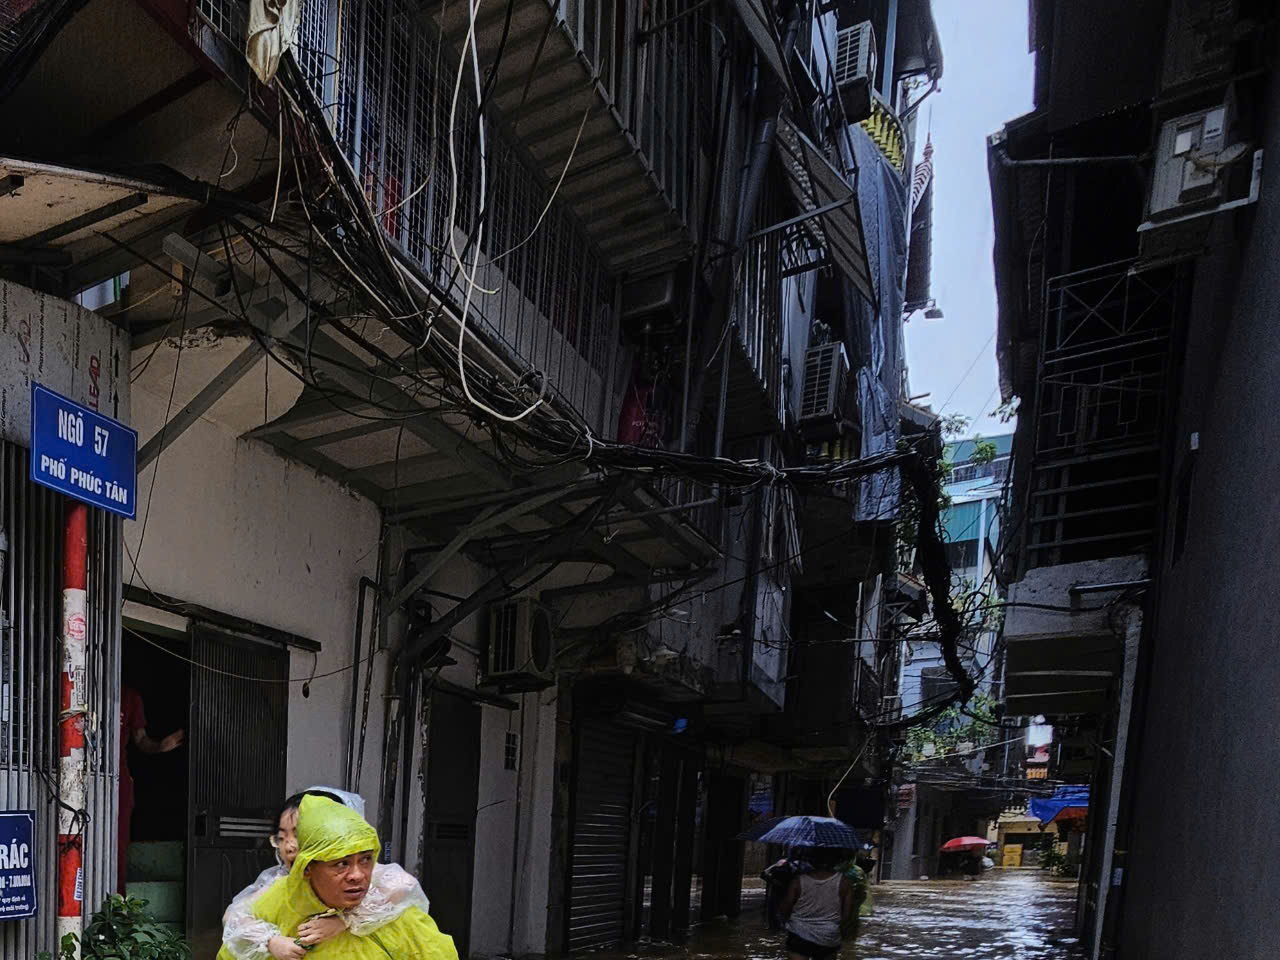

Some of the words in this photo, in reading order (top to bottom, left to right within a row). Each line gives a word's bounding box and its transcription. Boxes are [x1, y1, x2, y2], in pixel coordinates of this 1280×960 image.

[58, 408, 84, 447] NGÕ
[94, 425, 110, 457] 57
[40, 454, 68, 480] PHỐ
[70, 470, 102, 495] PHÚC
[105, 480, 128, 505] TÂN
